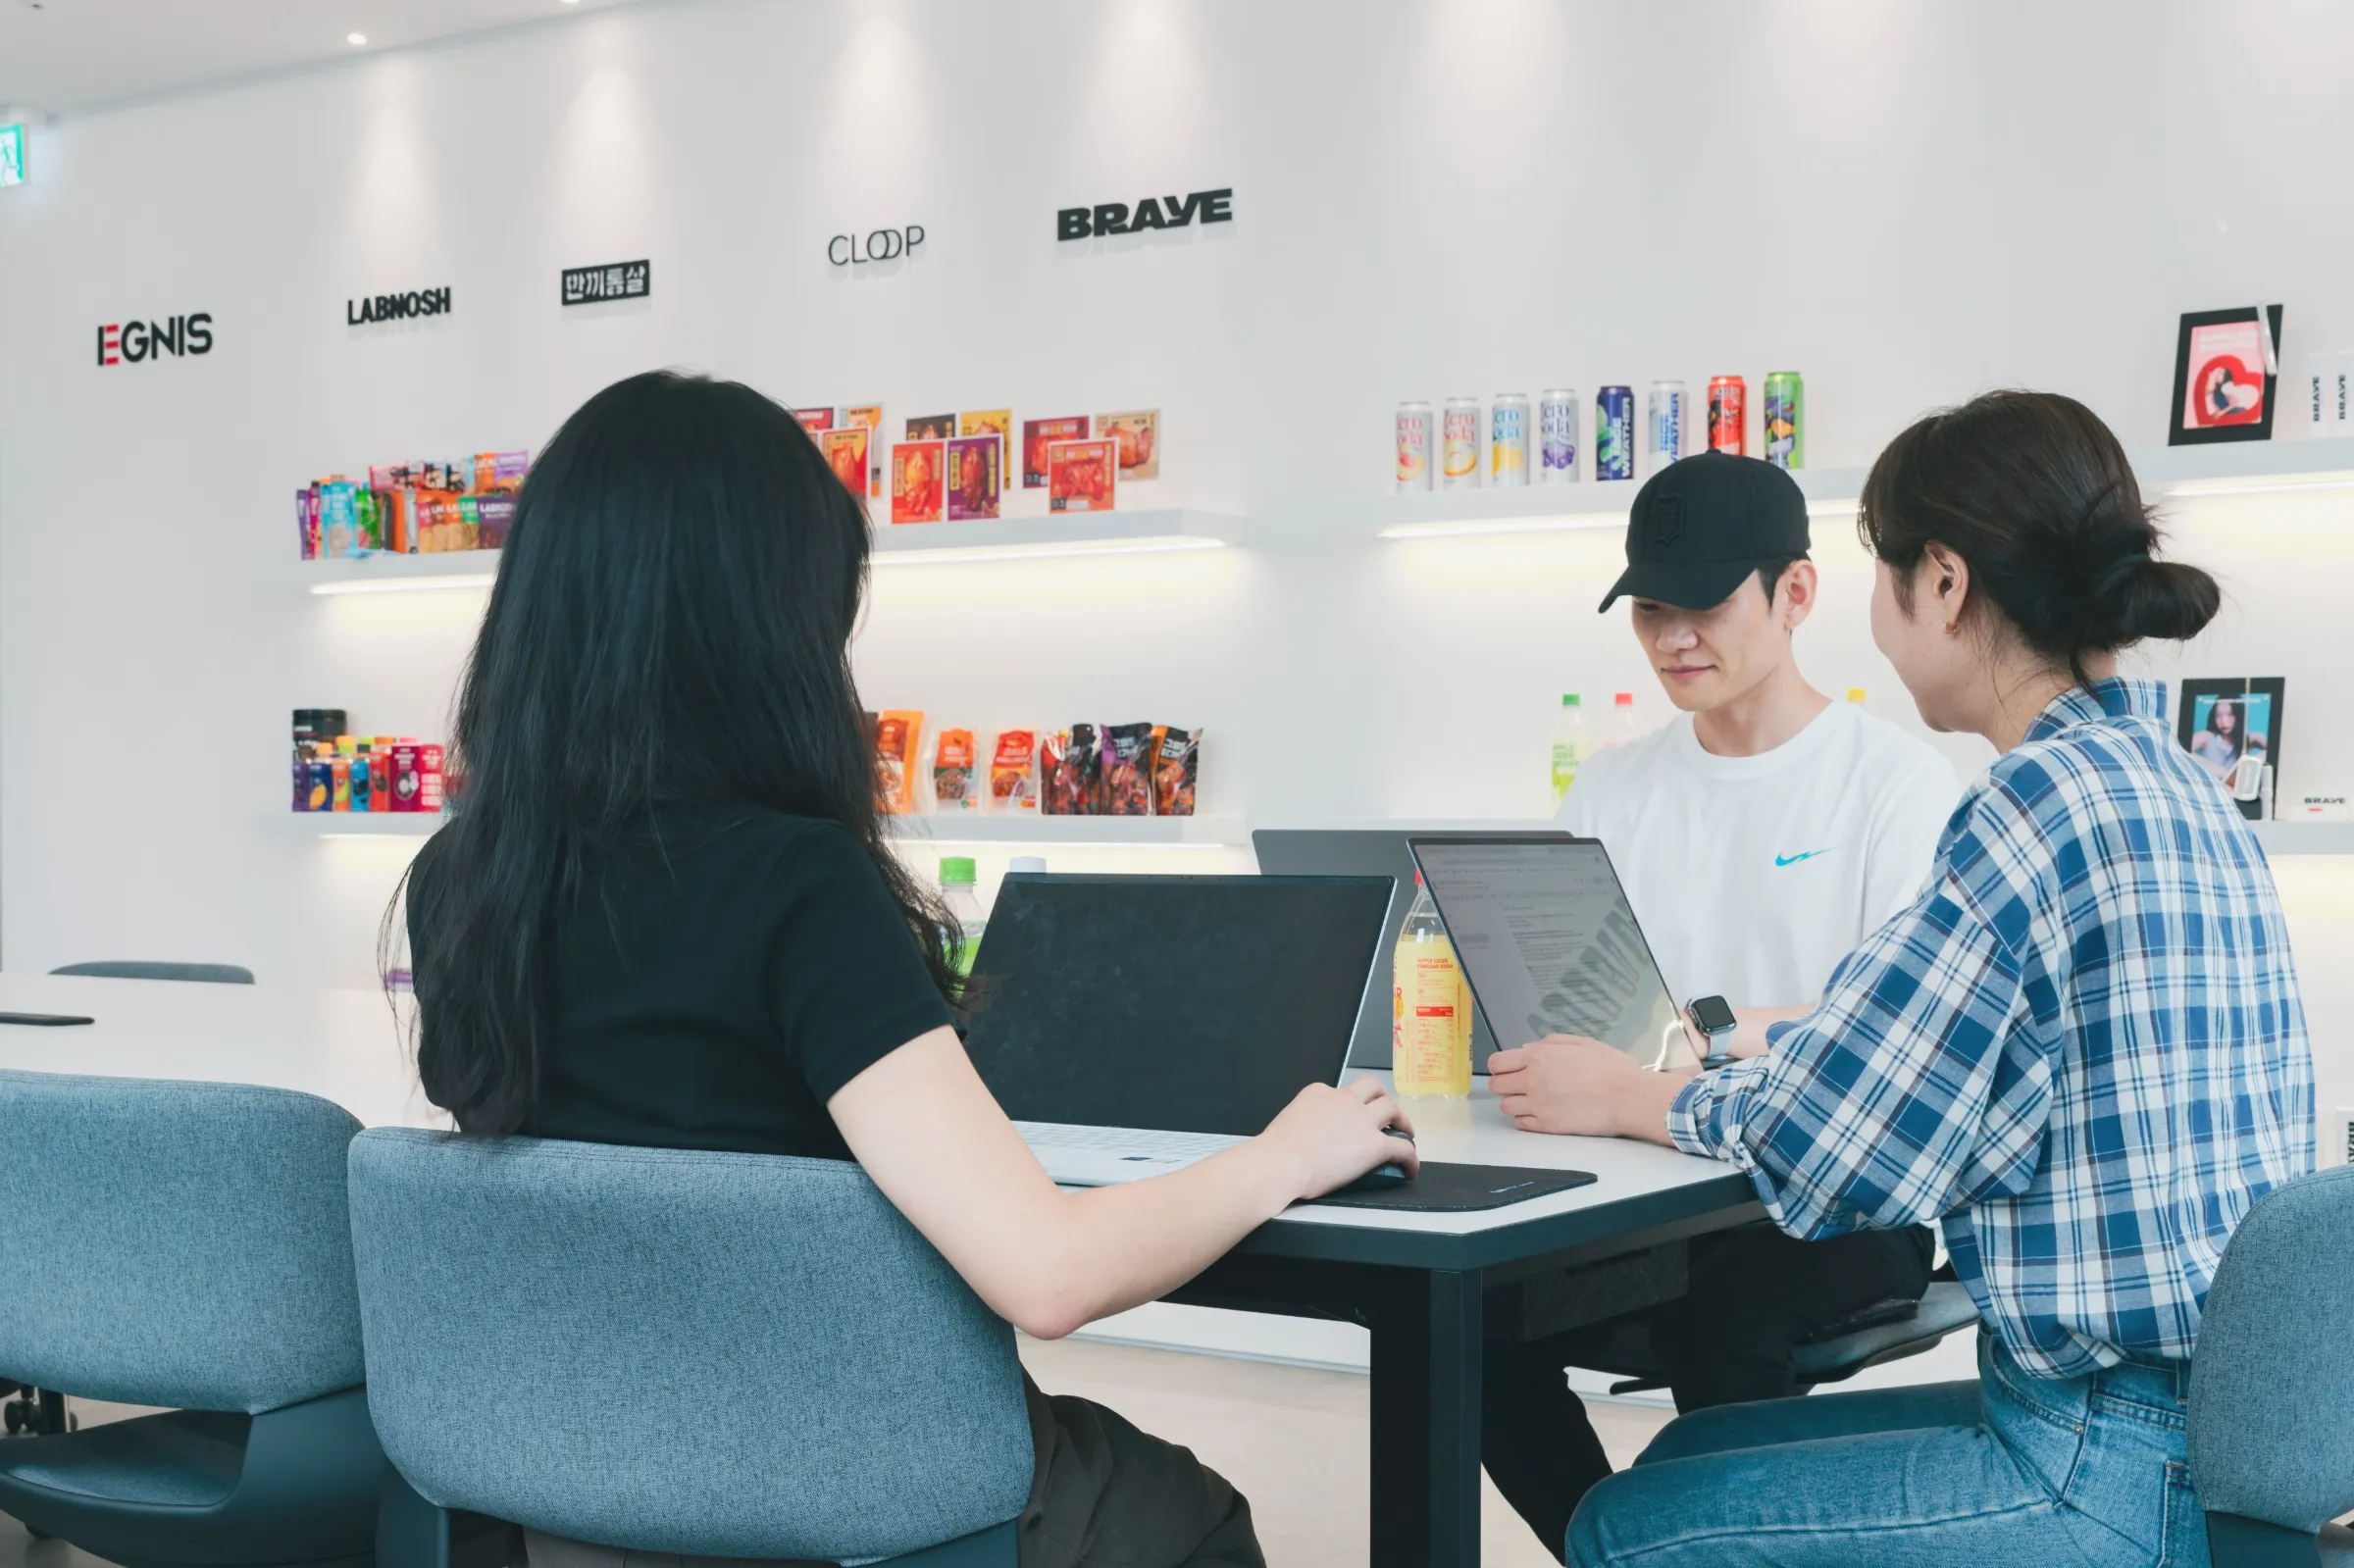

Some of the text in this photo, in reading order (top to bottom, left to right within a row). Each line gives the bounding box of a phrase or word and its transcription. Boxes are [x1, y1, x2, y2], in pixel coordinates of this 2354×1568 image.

[1057, 188, 1233, 241] BRAVE
[828, 226, 925, 266] CLOOP
[347, 287, 451, 325] LABNOSH
[98, 313, 213, 366] EGNIS
[1621, 396, 1630, 478] WEATHER
